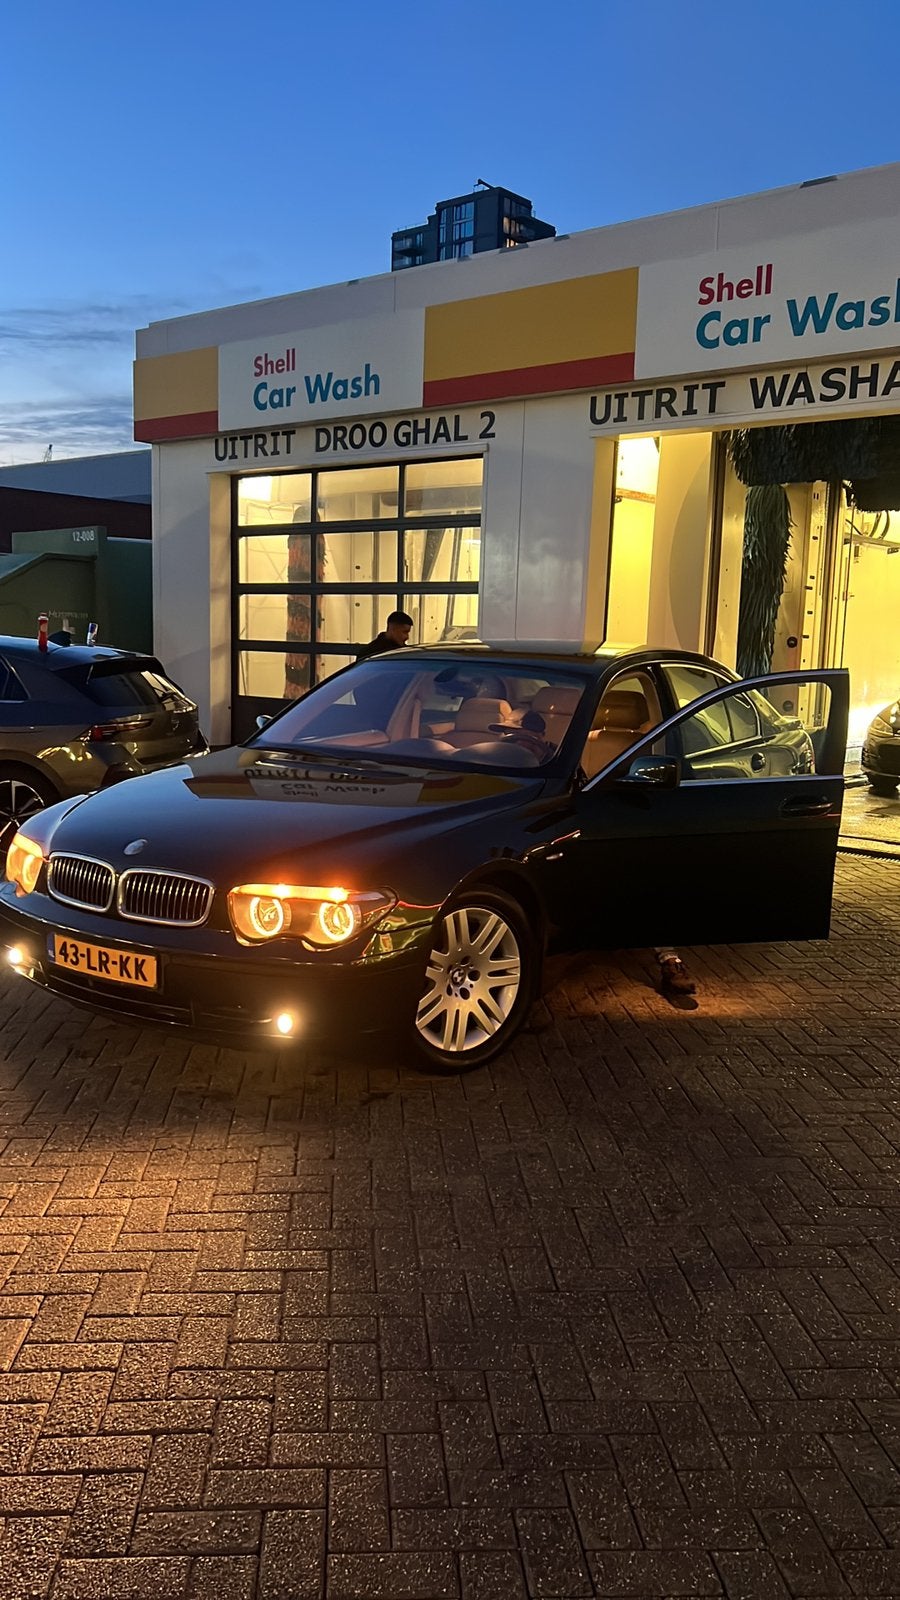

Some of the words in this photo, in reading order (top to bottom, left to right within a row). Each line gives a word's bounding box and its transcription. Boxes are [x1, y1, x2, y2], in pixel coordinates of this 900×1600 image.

[697, 264, 774, 305] Shell
[695, 311, 771, 349] Car
[253, 348, 296, 377] Shell
[253, 382, 296, 411] Car
[304, 363, 380, 404] Wash
[589, 381, 726, 425] UITRIT
[214, 430, 296, 461] UITRIT
[478, 411, 496, 439] 2
[58, 940, 148, 982] 43-LR-KK
